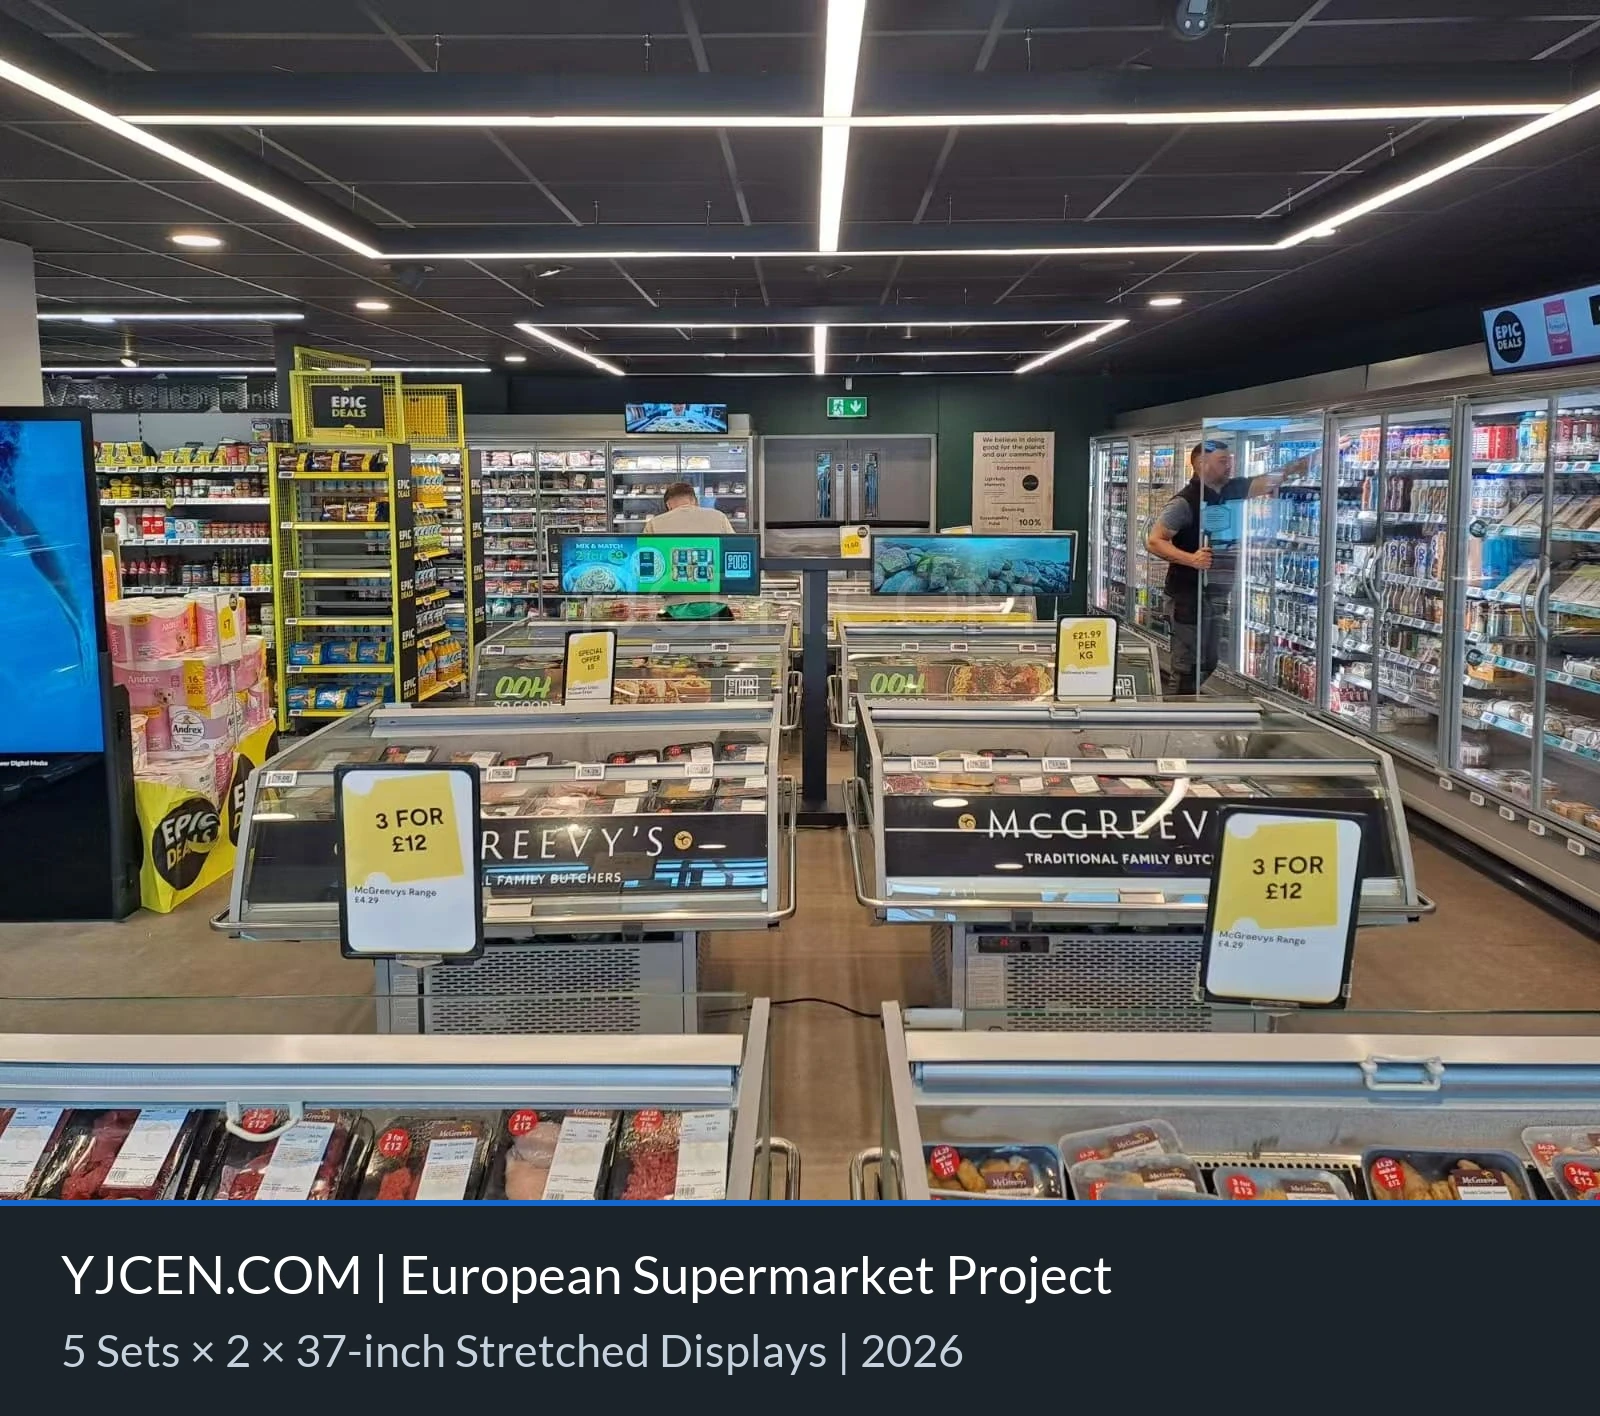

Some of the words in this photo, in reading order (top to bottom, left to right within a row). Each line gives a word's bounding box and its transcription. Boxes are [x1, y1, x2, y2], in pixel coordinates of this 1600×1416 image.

[1495, 322, 1521, 340] EPIC
[1497, 337, 1522, 351] DEALS
[330, 396, 367, 408] EPIC
[331, 408, 367, 418] DEALS
[1026, 436, 1045, 444] doing
[1008, 451, 1046, 459] community
[397, 479, 411, 490] EPIC
[1018, 518, 1042, 527] 100%
[399, 530, 412, 541] EPIC
[400, 579, 414, 591] EPIC
[402, 628, 415, 642] EPIC
[1072, 630, 1102, 640] £21.99
[1078, 640, 1097, 650] PER
[578, 648, 603, 657] SPECIAL
[1079, 651, 1094, 660] KG
[581, 655, 601, 664] OFFER
[128, 674, 160, 684] Andrex
[187, 675, 199, 684] 16
[403, 677, 417, 691] EPIC
[870, 673, 926, 695] OOH
[495, 676, 552, 698] OOH
[172, 724, 203, 735] Andrex
[375, 812, 389, 829] 3
[395, 807, 444, 828] FOR
[987, 807, 1209, 840] McGREEV
[161, 811, 220, 847] EPIC
[391, 834, 427, 853] £12
[481, 826, 664, 860] REEVY'S
[1025, 852, 1119, 866] TRADITIONAL
[1122, 852, 1171, 866] FAMILY
[1175, 853, 1215, 866] BUTC
[1252, 858, 1265, 875] 3
[1273, 856, 1325, 875] FOR
[496, 873, 545, 887] FAMILY
[550, 871, 622, 885] BUTCHERS
[353, 886, 407, 897] McGreevys
[408, 887, 437, 898] Range
[1265, 882, 1303, 900] £12
[354, 895, 379, 904] £4.29
[1218, 930, 1274, 944] McGreevys
[1276, 934, 1307, 946] Range
[251, 1109, 258, 1119] 3
[246, 1121, 266, 1129] £12
[513, 1122, 532, 1131] £12
[386, 1133, 393, 1142] 3
[393, 1134, 405, 1142] for
[383, 1142, 402, 1151] £12
[1375, 1160, 1393, 1169] £4.29
[1568, 1167, 1577, 1176] 3
[1577, 1168, 1590, 1176] for
[1231, 1178, 1239, 1187] 3
[1388, 1179, 1401, 1188] £12
[1573, 1176, 1594, 1186] £12
[1234, 1186, 1254, 1196] £12
